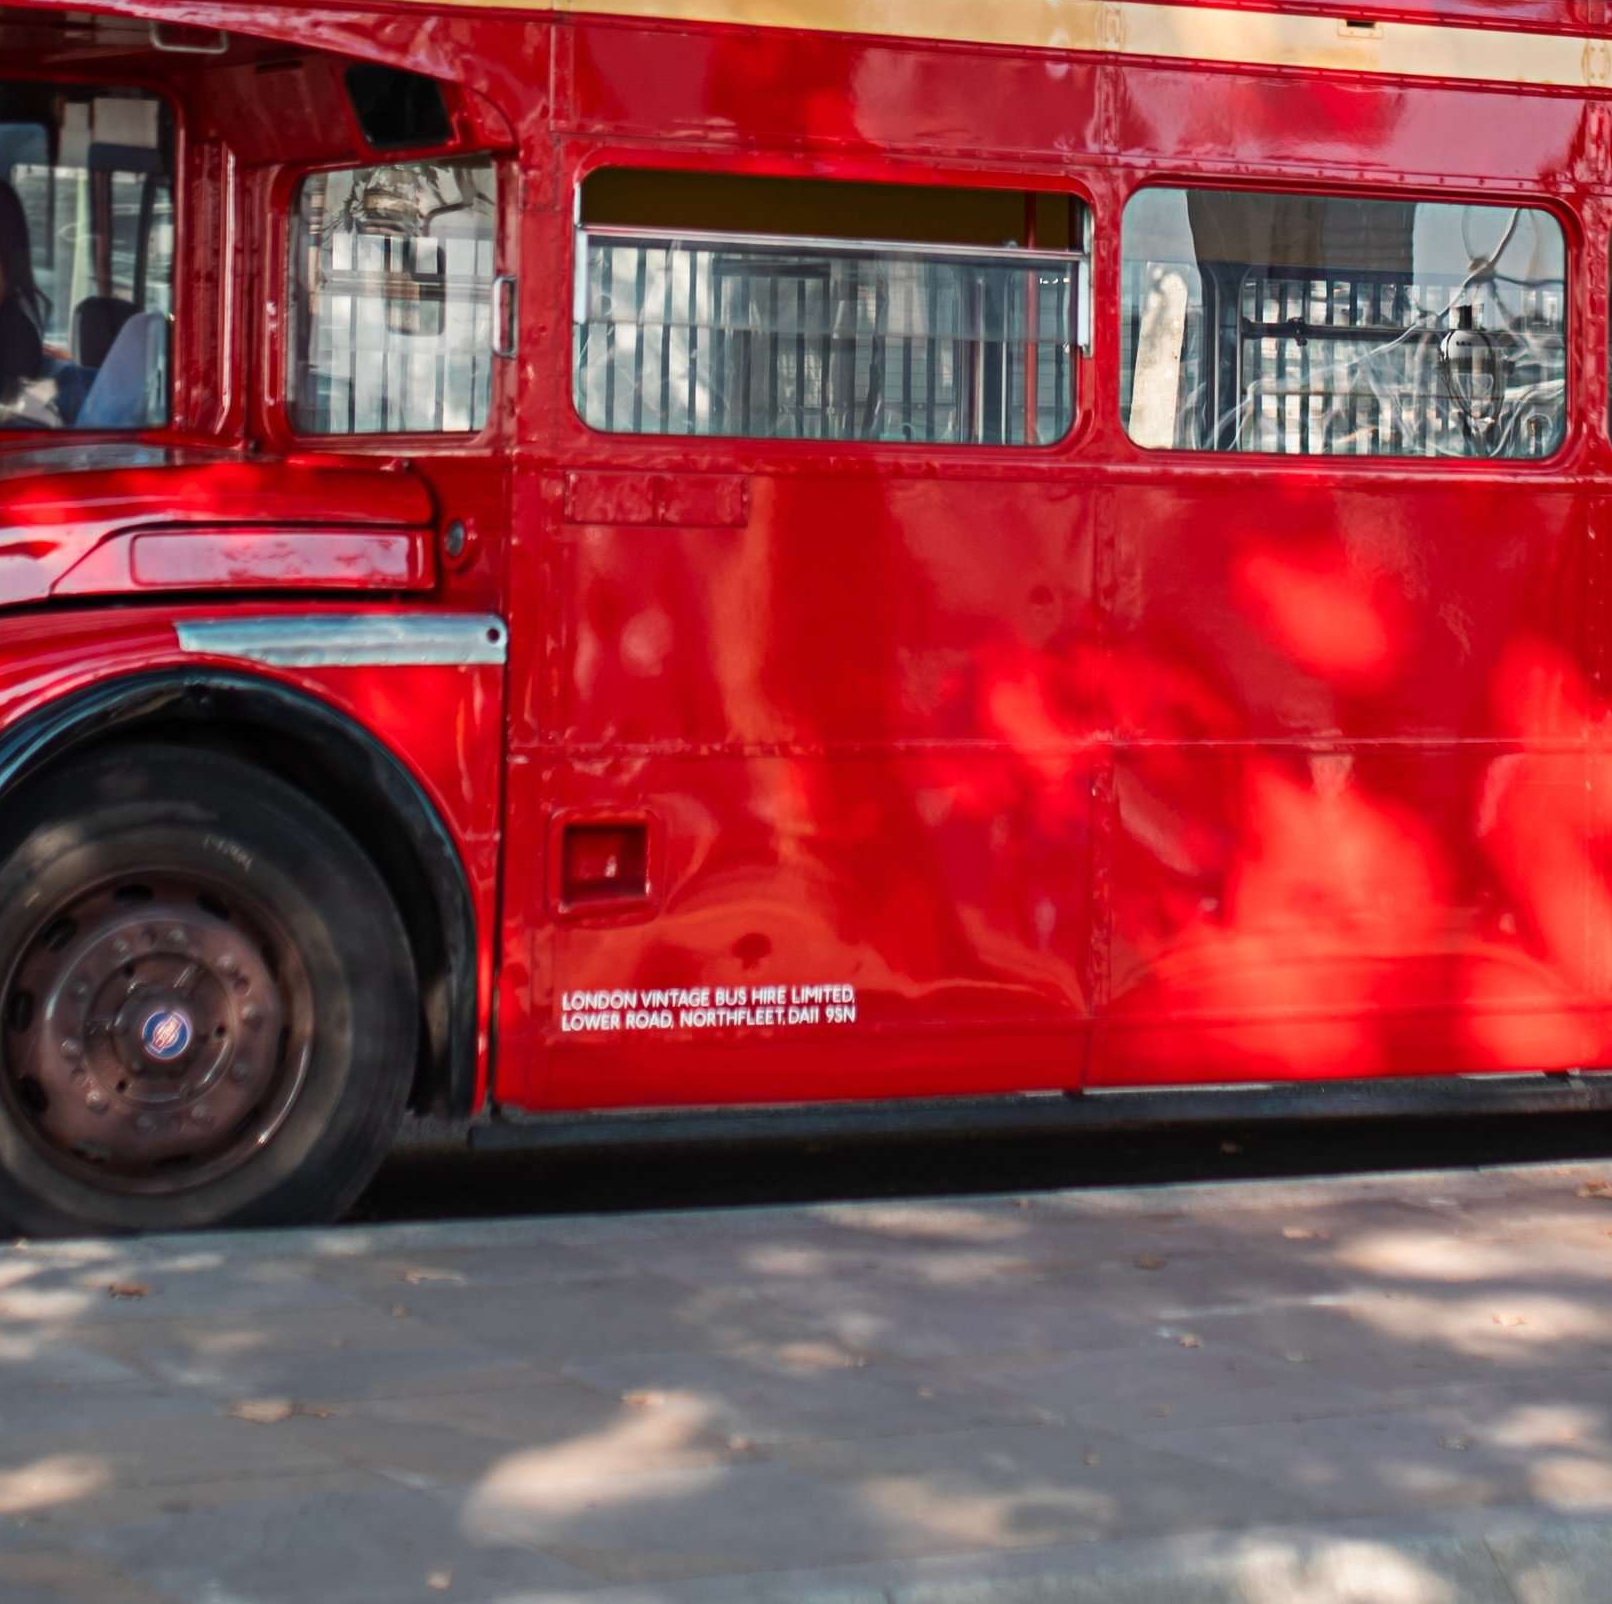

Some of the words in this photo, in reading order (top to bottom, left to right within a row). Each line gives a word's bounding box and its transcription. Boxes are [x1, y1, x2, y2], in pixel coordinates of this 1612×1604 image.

[562, 989, 637, 1011] LONDON
[640, 987, 710, 1008] VINTAGE
[715, 986, 747, 1007] BUS
[751, 985, 787, 1006] HIRE
[562, 1010, 621, 1032] LOWER
[825, 1004, 856, 1024] 9SN
